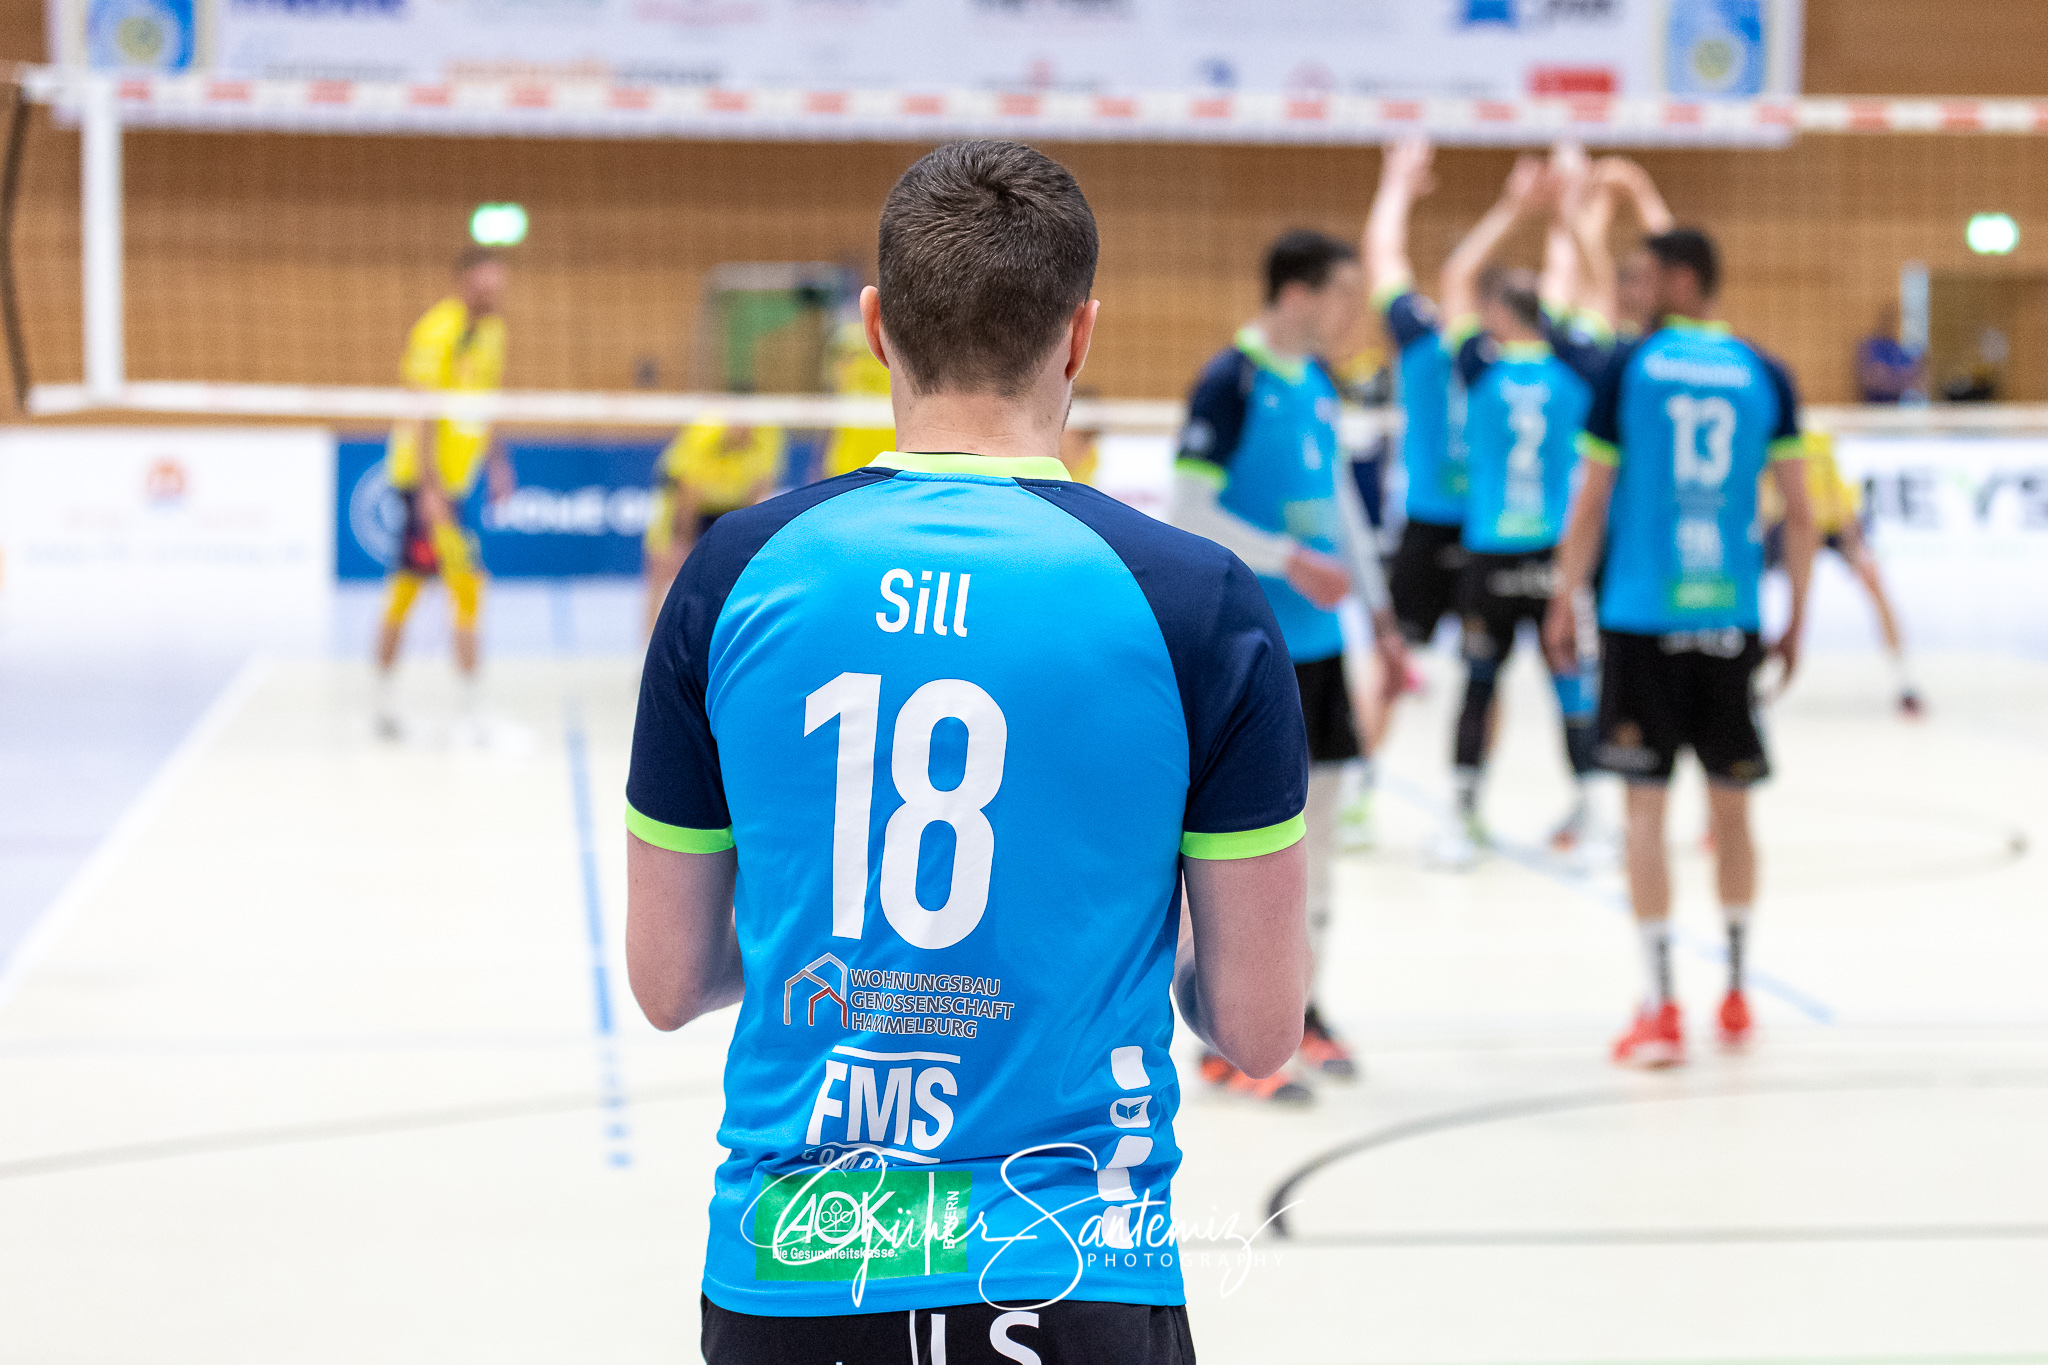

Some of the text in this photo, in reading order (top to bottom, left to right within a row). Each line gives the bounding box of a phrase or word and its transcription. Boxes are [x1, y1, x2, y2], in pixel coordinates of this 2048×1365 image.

[1665, 394, 1738, 486] 13
[875, 567, 972, 638] Sill
[803, 671, 1008, 950] 18
[850, 968, 1001, 997] WOHNUNGSBAU
[850, 990, 1015, 1021] GENOSSENSCHAFT
[852, 1012, 978, 1039] HAMMELBURG
[805, 1058, 958, 1151] FMS
[776, 1190, 896, 1245] AOK
